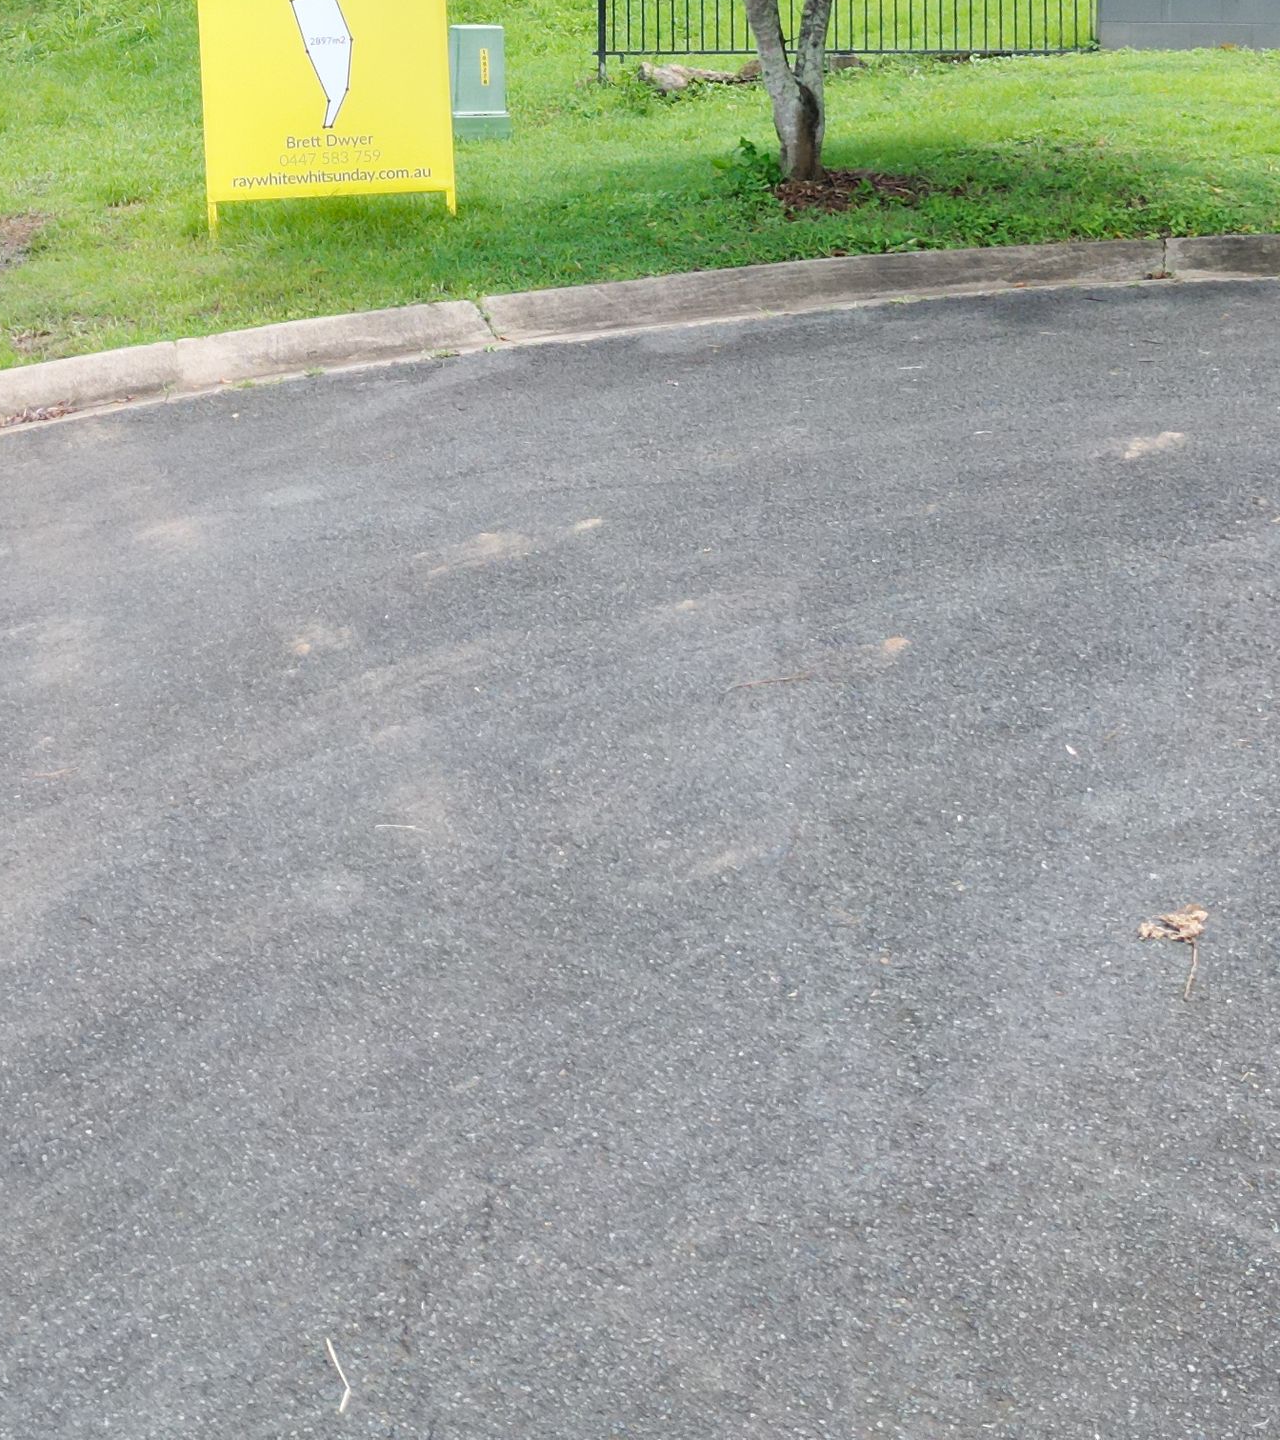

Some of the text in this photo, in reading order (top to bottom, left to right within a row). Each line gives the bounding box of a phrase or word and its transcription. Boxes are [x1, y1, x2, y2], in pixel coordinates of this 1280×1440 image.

[286, 134, 374, 149] Brett Dwyer
[279, 149, 381, 167] 0447 583 759
[233, 167, 431, 189] raywhitewhitsunday.com.au
